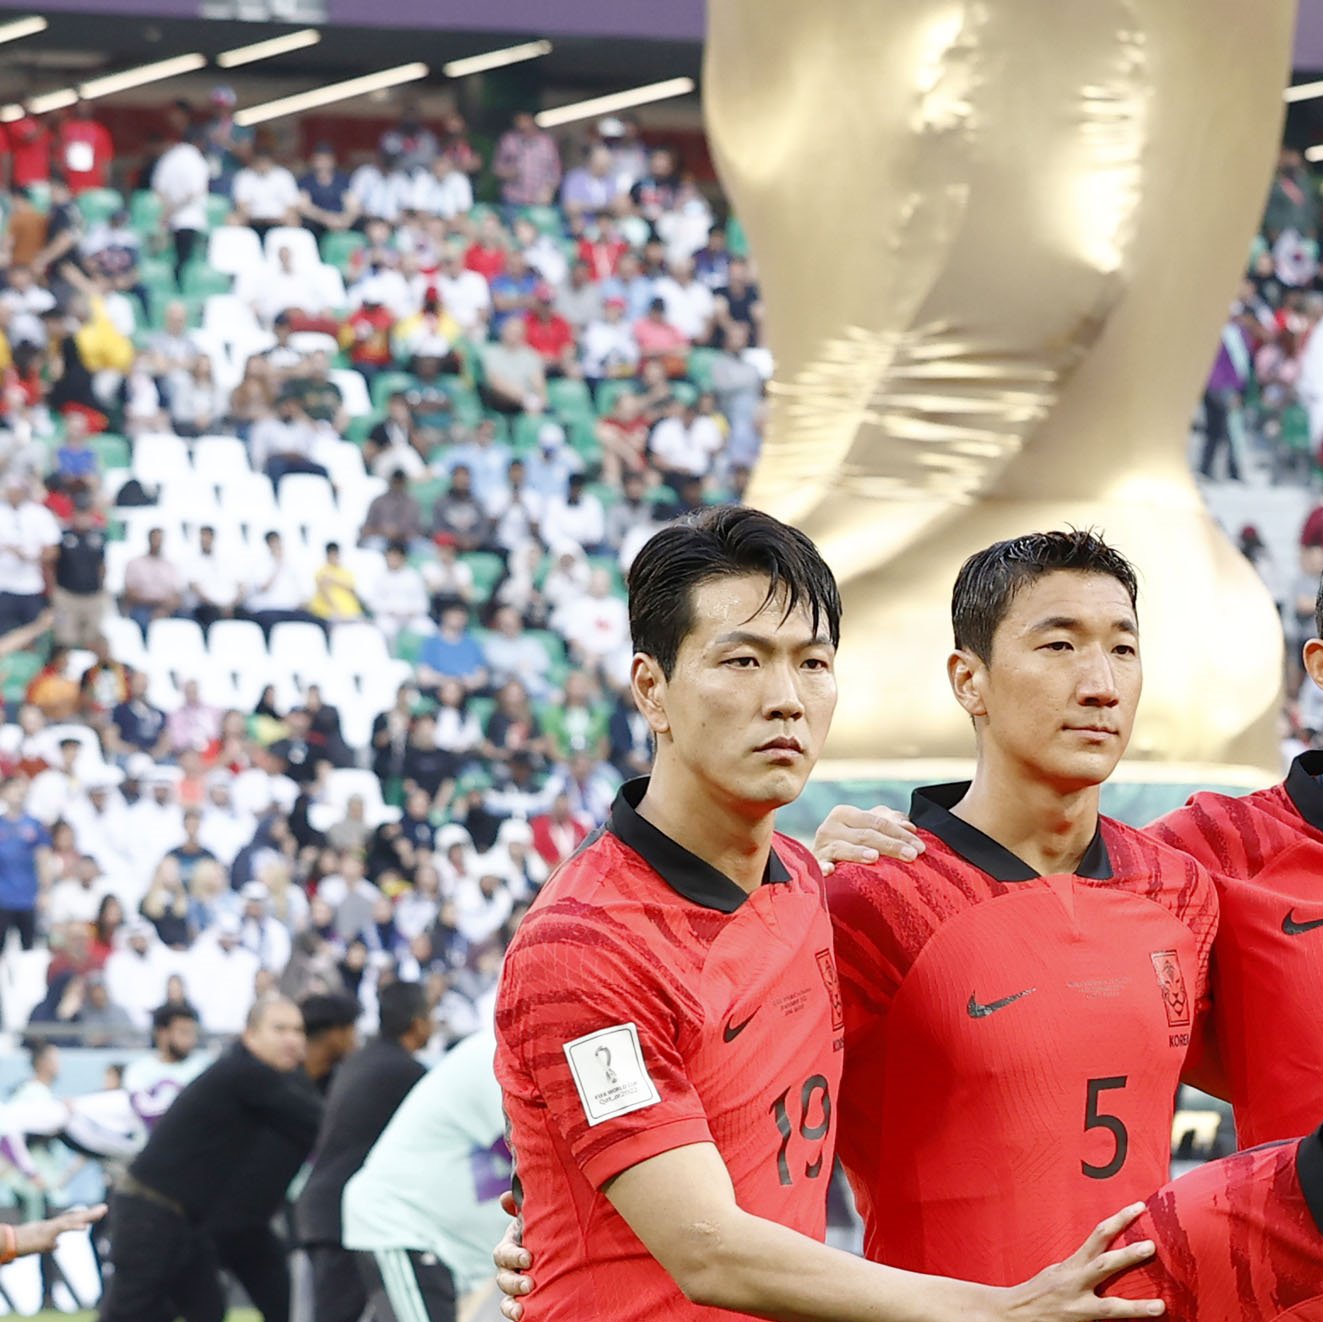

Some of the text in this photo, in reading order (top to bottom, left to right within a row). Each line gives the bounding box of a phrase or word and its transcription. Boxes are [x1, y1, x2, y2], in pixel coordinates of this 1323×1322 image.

[1169, 1034, 1189, 1048] KORE
[769, 1074, 831, 1186] 19
[1080, 1075, 1129, 1180] 5
